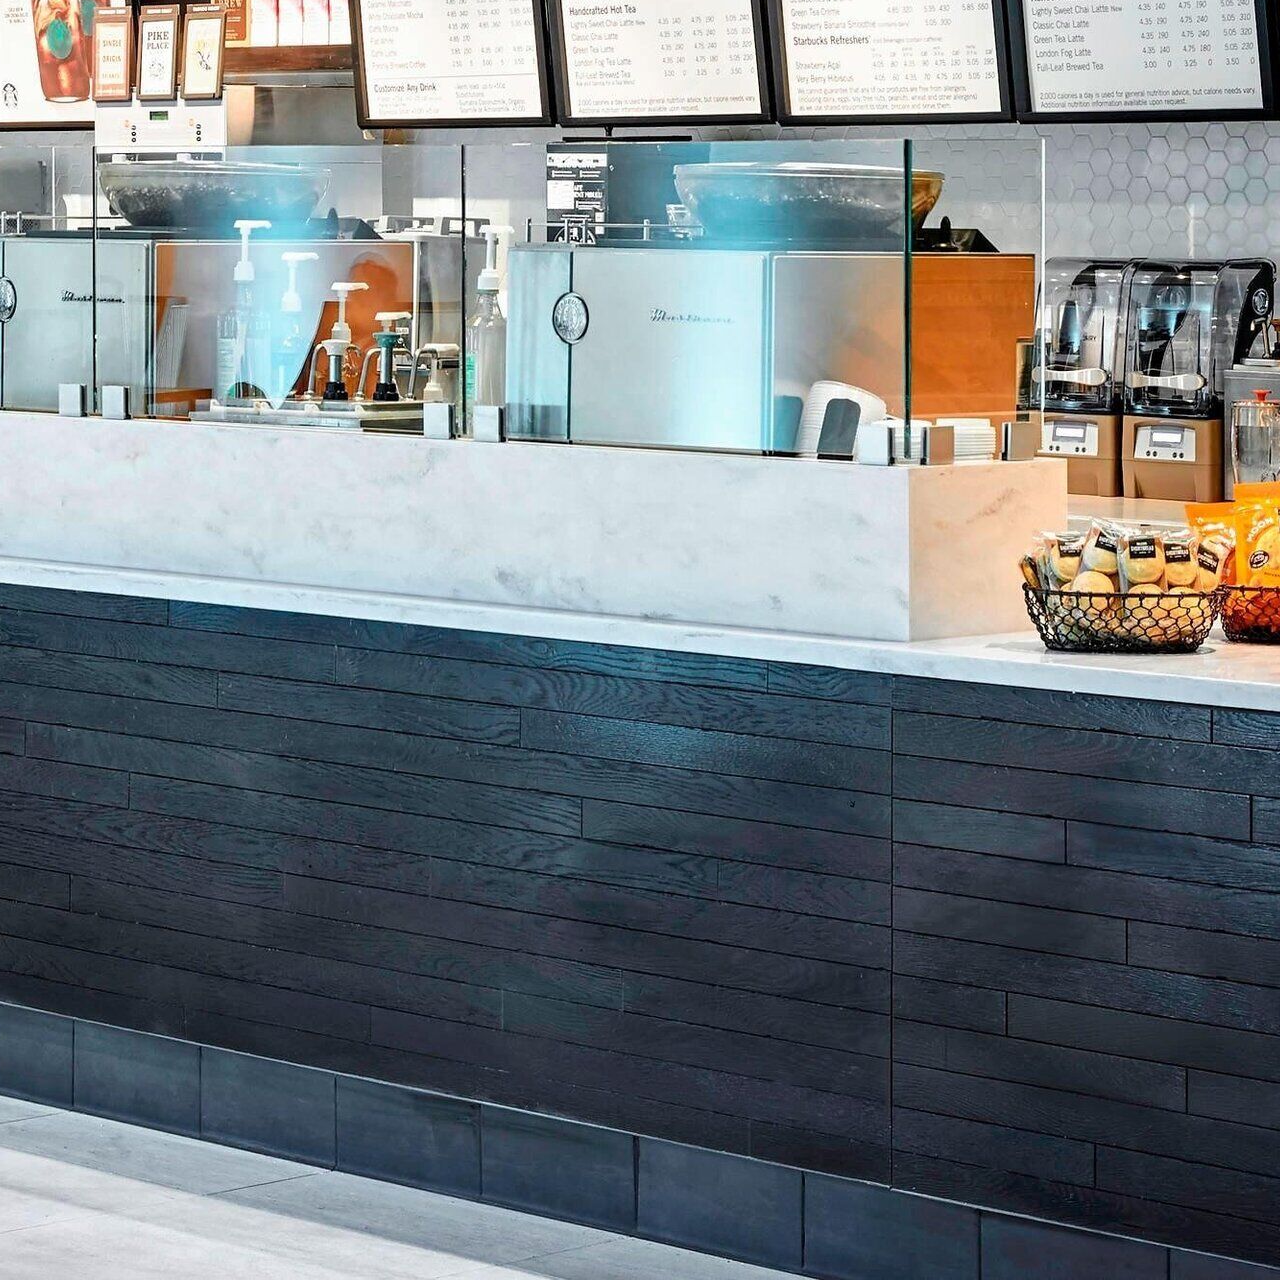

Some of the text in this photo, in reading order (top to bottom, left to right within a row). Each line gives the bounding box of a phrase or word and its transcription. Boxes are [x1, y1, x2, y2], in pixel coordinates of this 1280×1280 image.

[569, 6, 608, 16] Handcrafted
[610, 6, 622, 14] Hot
[1031, 5, 1122, 16] Lightly Sweet Chai Latte New
[1032, 20, 1089, 30] Classic Chai Latte
[148, 32, 169, 40] PIKE
[793, 35, 868, 46] Starbucks Refreshers
[1033, 35, 1084, 44] Green Tea Latte
[146, 42, 169, 50] PLACE
[1035, 48, 1091, 58] London Fog Latte
[1036, 62, 1104, 72] Full-Leaf Brewed Tea
[374, 84, 436, 93] Customize Any Drink
[1247, 517, 1274, 542] MOON
